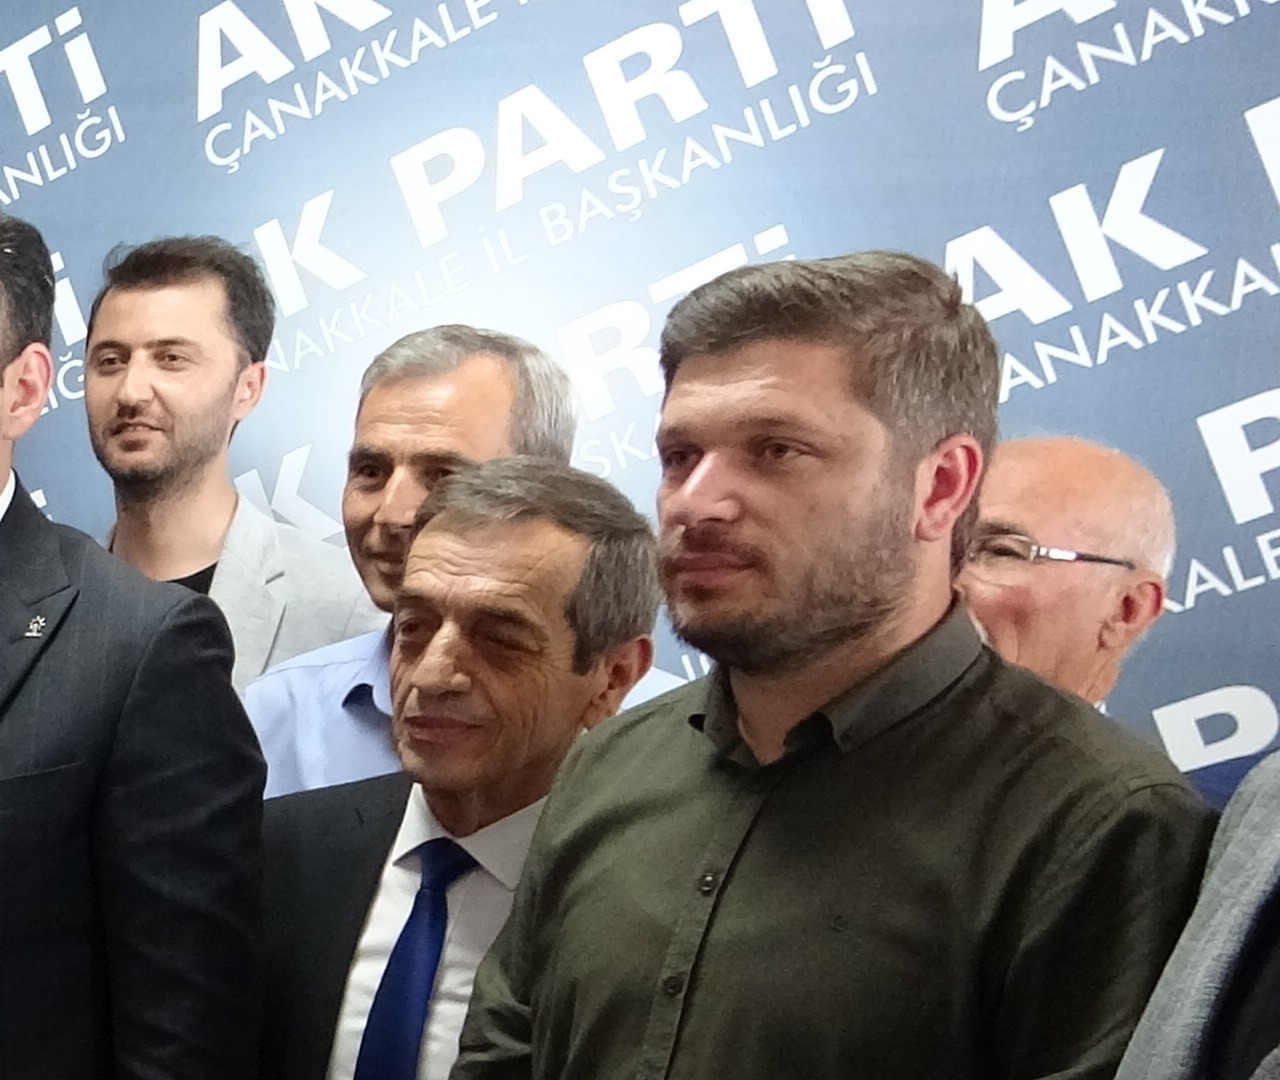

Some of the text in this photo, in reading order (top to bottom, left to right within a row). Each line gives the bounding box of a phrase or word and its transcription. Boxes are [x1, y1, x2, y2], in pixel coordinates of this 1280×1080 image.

[204, 0, 498, 174] ÇANAKKALE
[538, 51, 878, 248] BAŞKANLIĞI
[944, 147, 1210, 325] AK
